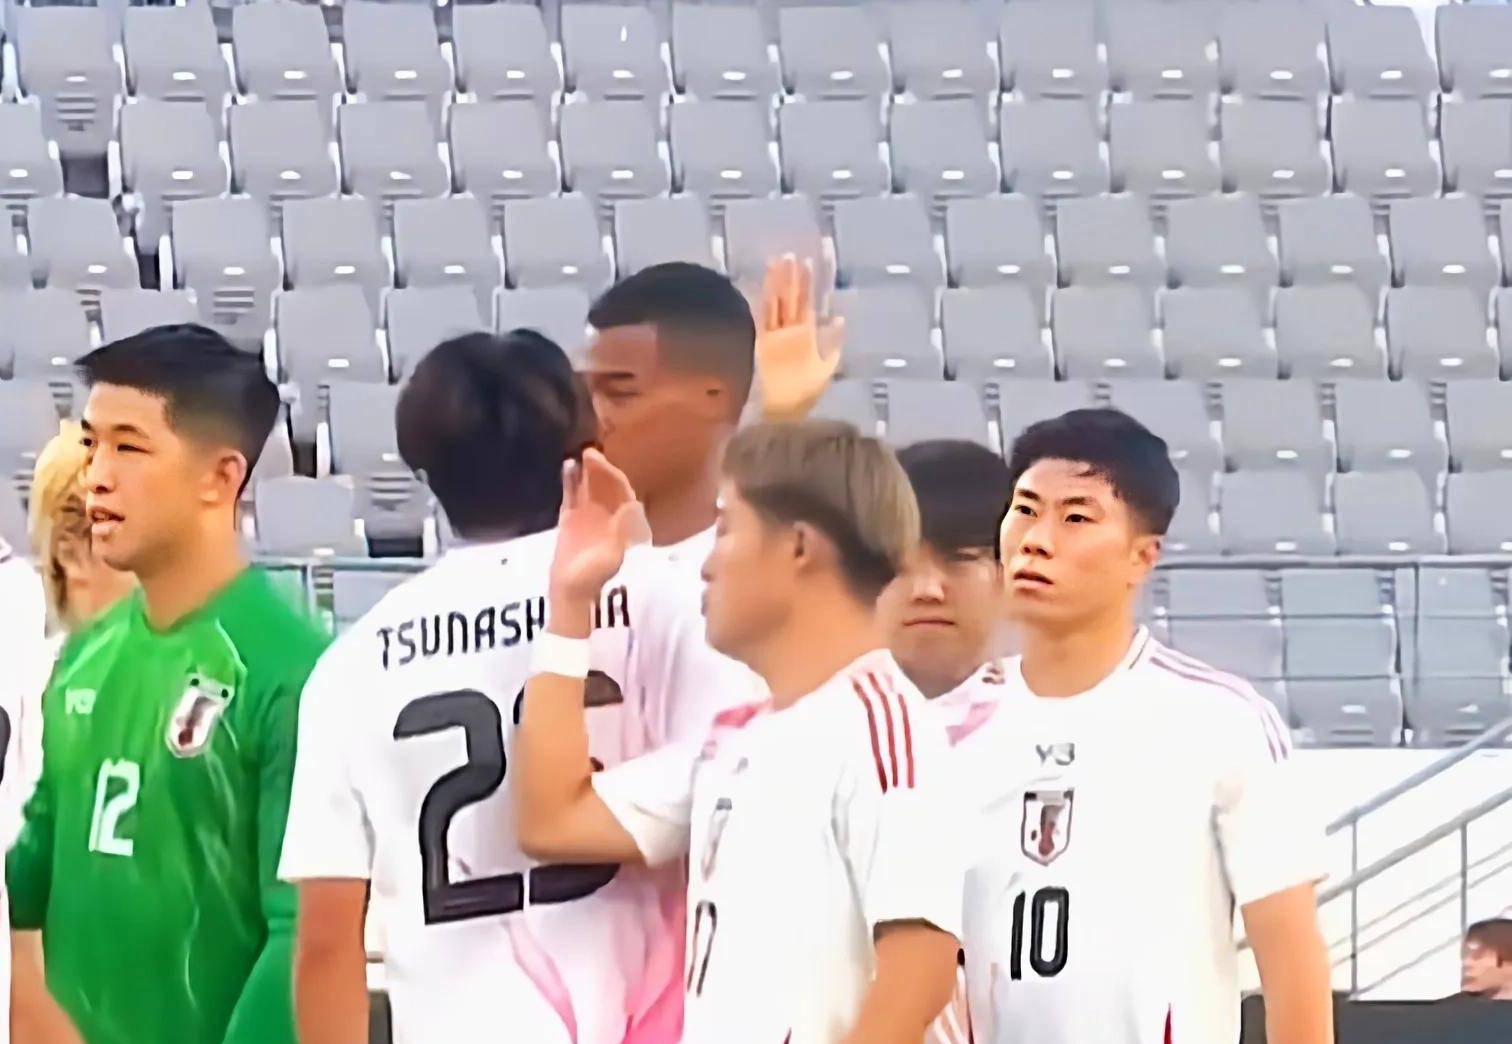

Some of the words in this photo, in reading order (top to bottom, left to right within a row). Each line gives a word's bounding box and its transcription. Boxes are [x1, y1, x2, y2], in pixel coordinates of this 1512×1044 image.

[377, 585, 630, 670] TSUNASHA
[89, 757, 141, 856] 12
[1010, 886, 1070, 981] 10
